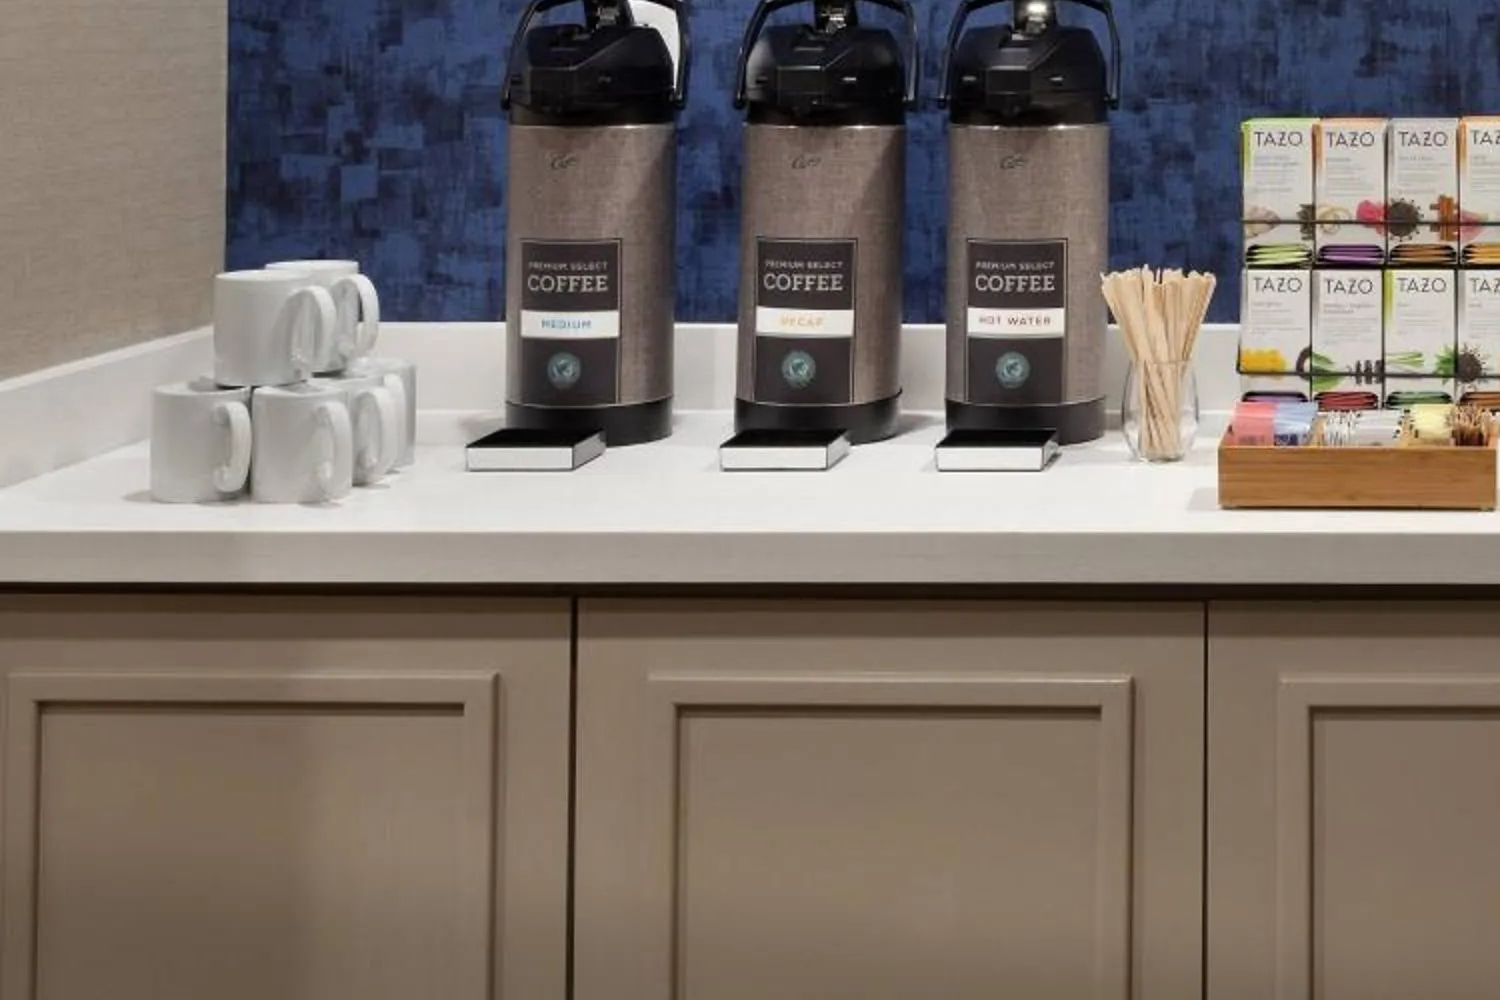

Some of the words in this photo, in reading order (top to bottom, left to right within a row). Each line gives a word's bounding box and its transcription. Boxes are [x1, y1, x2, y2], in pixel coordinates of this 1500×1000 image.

[1254, 131, 1303, 147] TAZO
[1325, 131, 1375, 148] TAZO
[1398, 130, 1448, 147] TAZO
[527, 274, 609, 293] COFFEE
[763, 273, 844, 291] COFFEE
[975, 274, 1056, 293] COFFEE
[1253, 276, 1303, 293] TAZO
[1324, 278, 1374, 295] TAZO
[1397, 276, 1447, 293] TAZO
[541, 318, 593, 330] MEDIUM
[978, 315, 1001, 325] HOT
[1007, 315, 1052, 326] WATER
